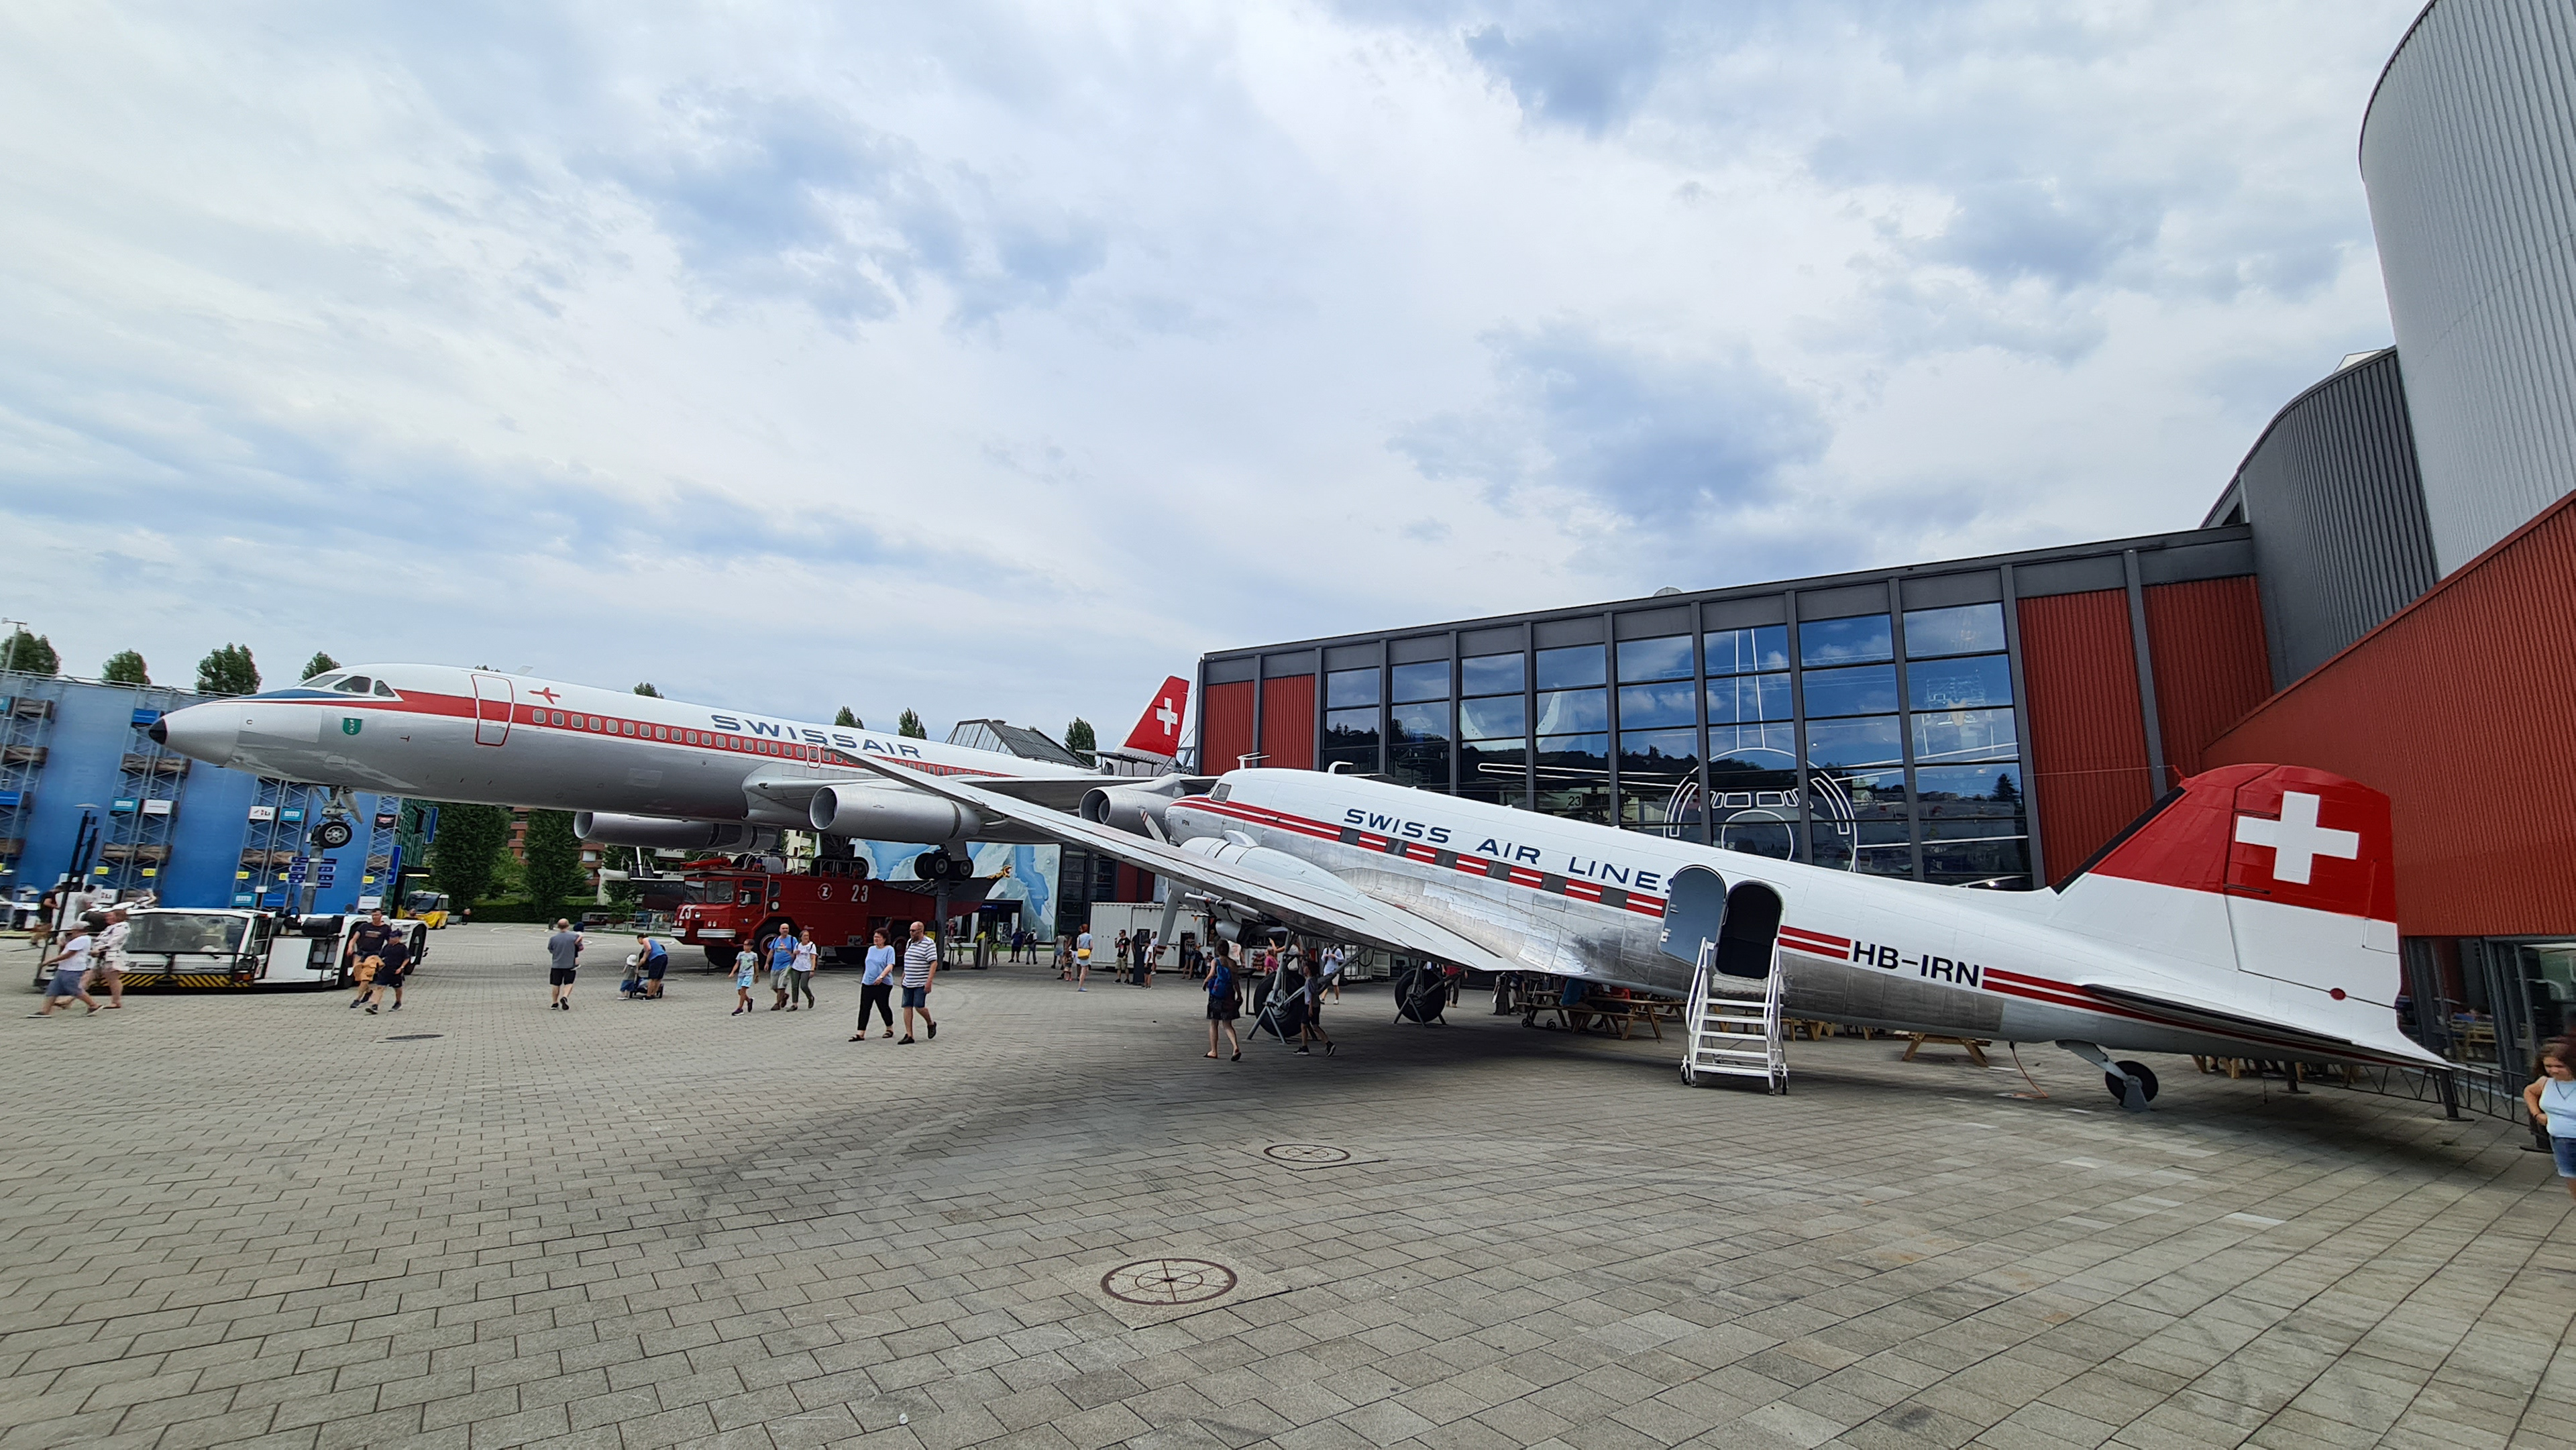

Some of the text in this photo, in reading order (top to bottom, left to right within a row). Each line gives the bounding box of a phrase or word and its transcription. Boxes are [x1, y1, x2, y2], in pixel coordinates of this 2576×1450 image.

[711, 714, 922, 759] SWISSAIR
[1568, 795, 1581, 807] 23
[1344, 808, 1452, 844] SWISS
[1476, 838, 1541, 865] AIR
[851, 884, 869, 902] 23
[1853, 940, 1980, 987] HB-IRN
